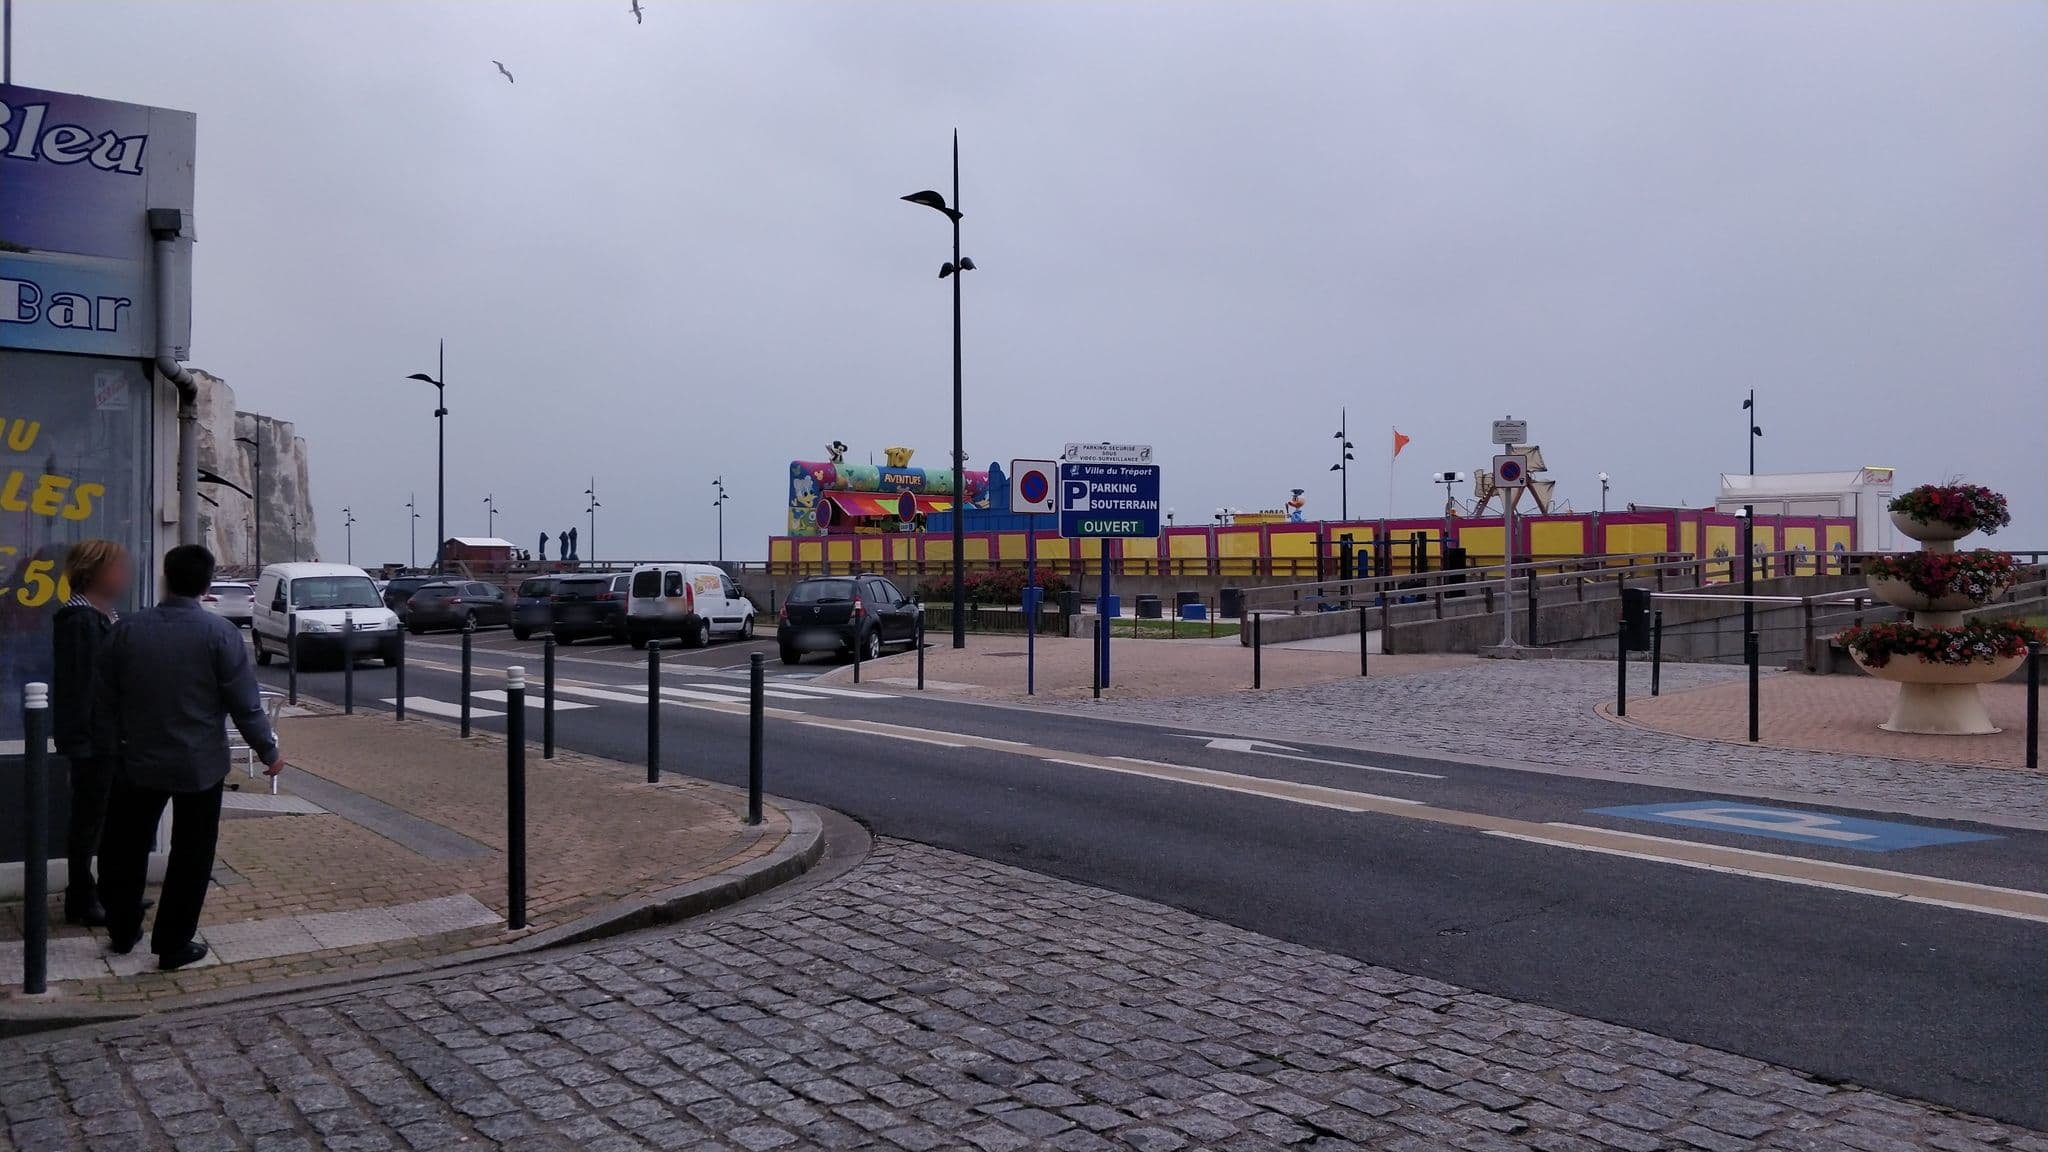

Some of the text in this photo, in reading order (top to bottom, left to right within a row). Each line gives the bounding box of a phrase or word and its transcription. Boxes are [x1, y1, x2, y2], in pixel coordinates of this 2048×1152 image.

[0, 278, 131, 332] Bar
[1084, 466, 1152, 476] Ville du Tréport
[1091, 483, 1137, 494] PARKING
[1091, 500, 1158, 510] SOUTERRAIN
[1084, 521, 1138, 533] OUVERT
